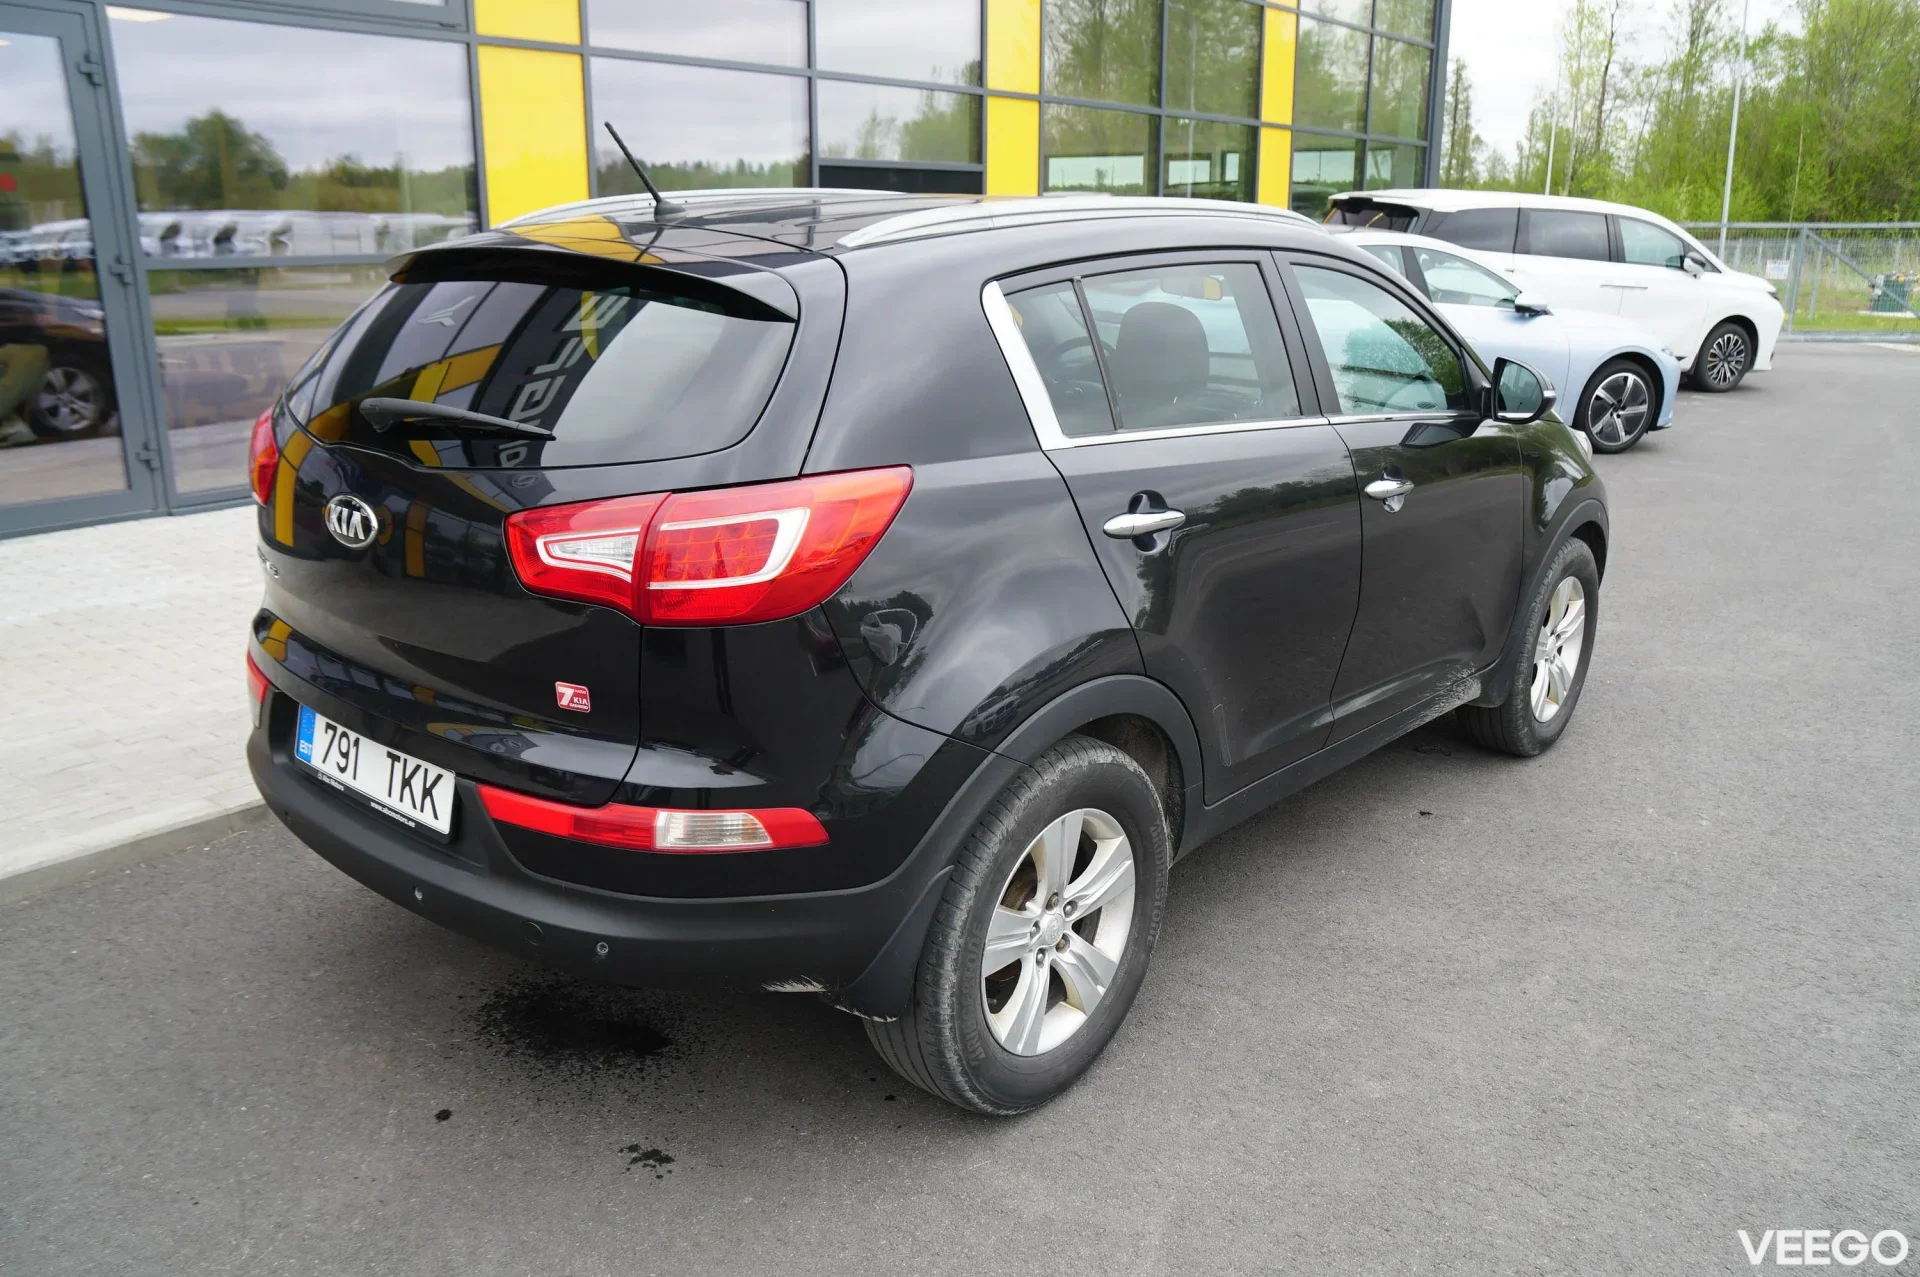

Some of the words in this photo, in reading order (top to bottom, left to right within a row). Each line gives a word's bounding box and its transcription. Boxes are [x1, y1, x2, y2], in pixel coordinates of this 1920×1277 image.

[329, 503, 365, 540] KIA
[557, 686, 575, 706] 7
[573, 696, 588, 706] KIA
[300, 739, 312, 756] EST
[322, 721, 360, 781] 791
[386, 750, 443, 821] TKK
